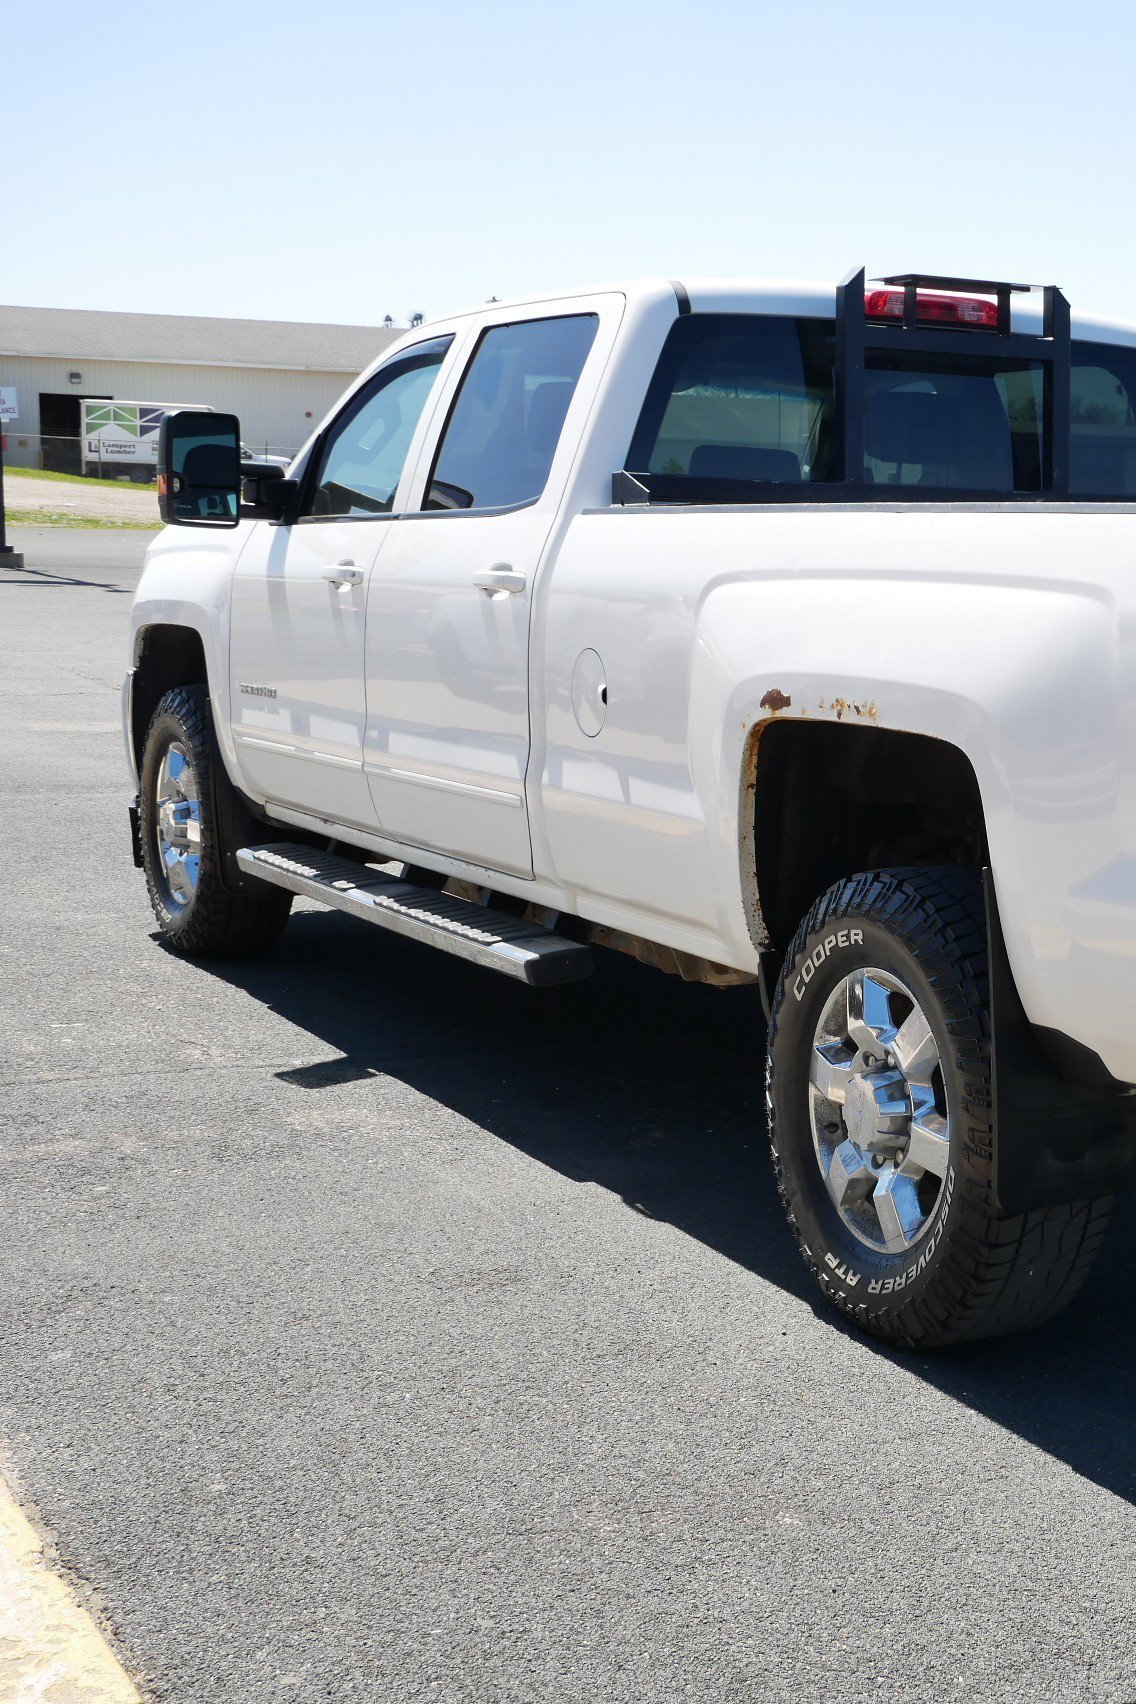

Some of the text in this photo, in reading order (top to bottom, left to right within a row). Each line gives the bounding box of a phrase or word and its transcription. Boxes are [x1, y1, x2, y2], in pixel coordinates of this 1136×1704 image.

[102, 442, 136, 450] Lampert
[793, 929, 863, 1002] COOPER
[867, 1165, 956, 1295] DISCOVERER
